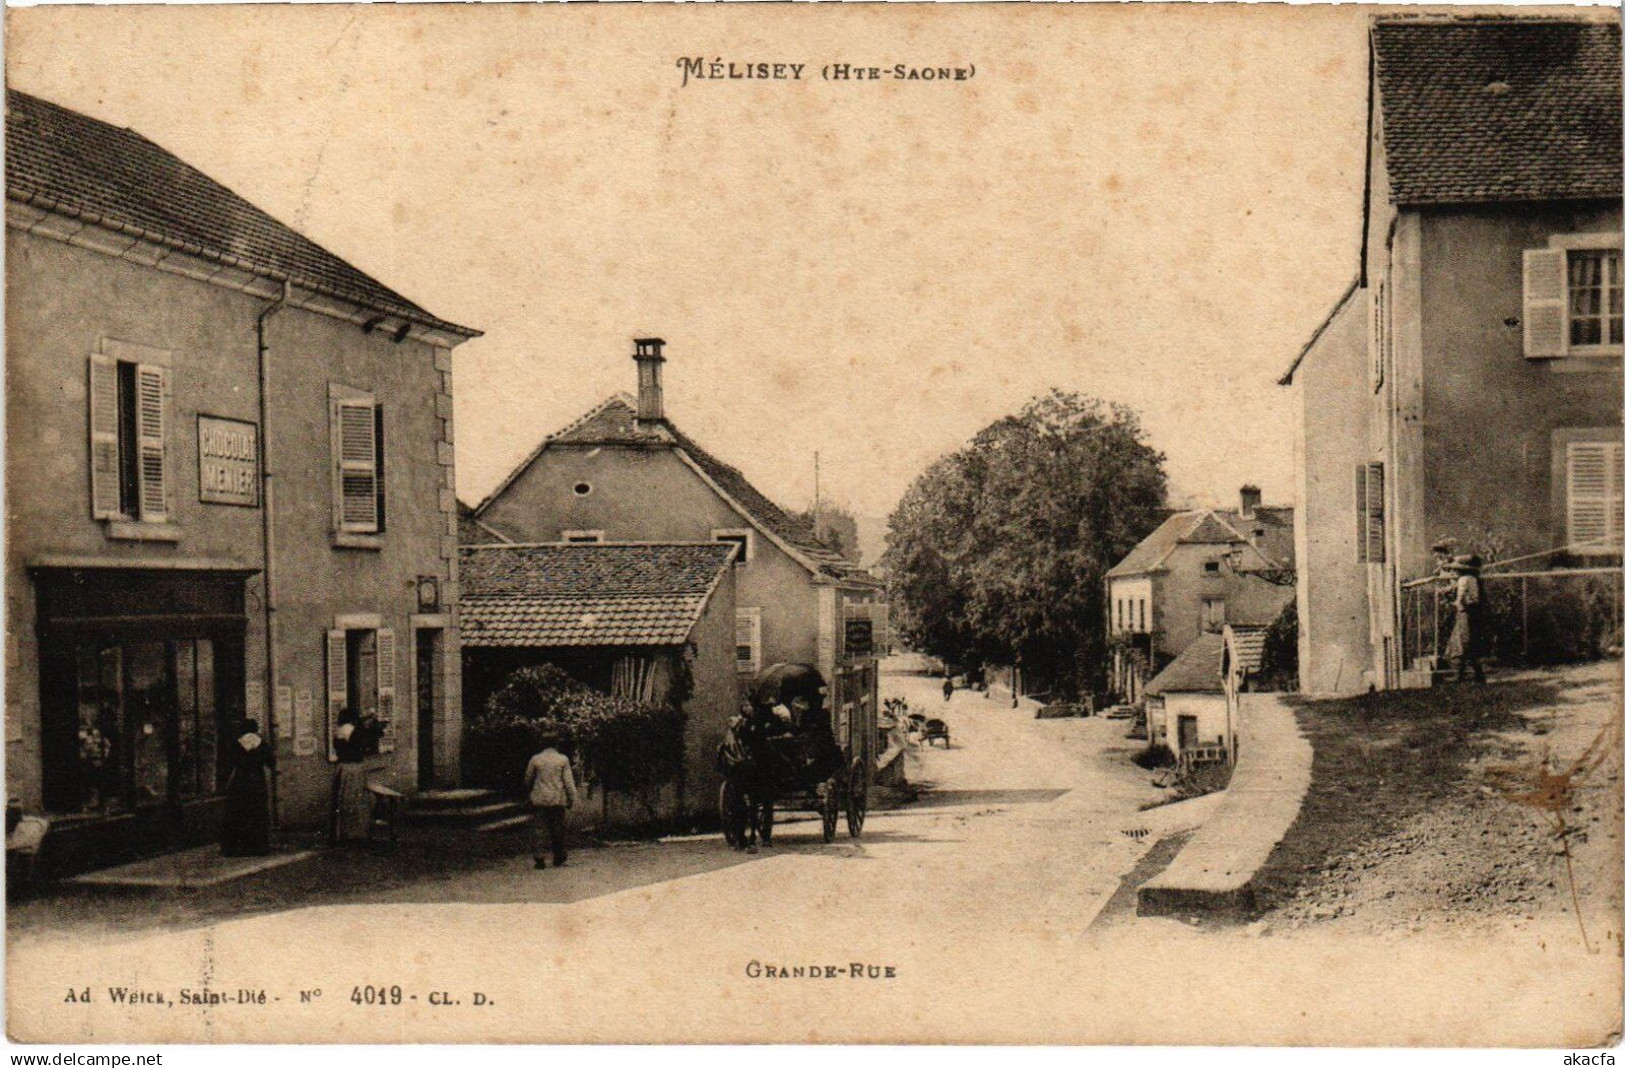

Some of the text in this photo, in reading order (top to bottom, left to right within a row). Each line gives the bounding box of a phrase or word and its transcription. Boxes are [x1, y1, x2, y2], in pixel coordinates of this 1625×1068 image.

[675, 57, 805, 88] MÉLISEY
[202, 427, 257, 460] CHOCOLAT
[205, 464, 256, 496] MENIER
[745, 960, 897, 979] GRANDE-RUE
[180, 988, 266, 1005] Saint-Dié
[350, 985, 402, 1006] 4019
[428, 991, 461, 1006] CL.
[473, 992, 495, 1006] D.
